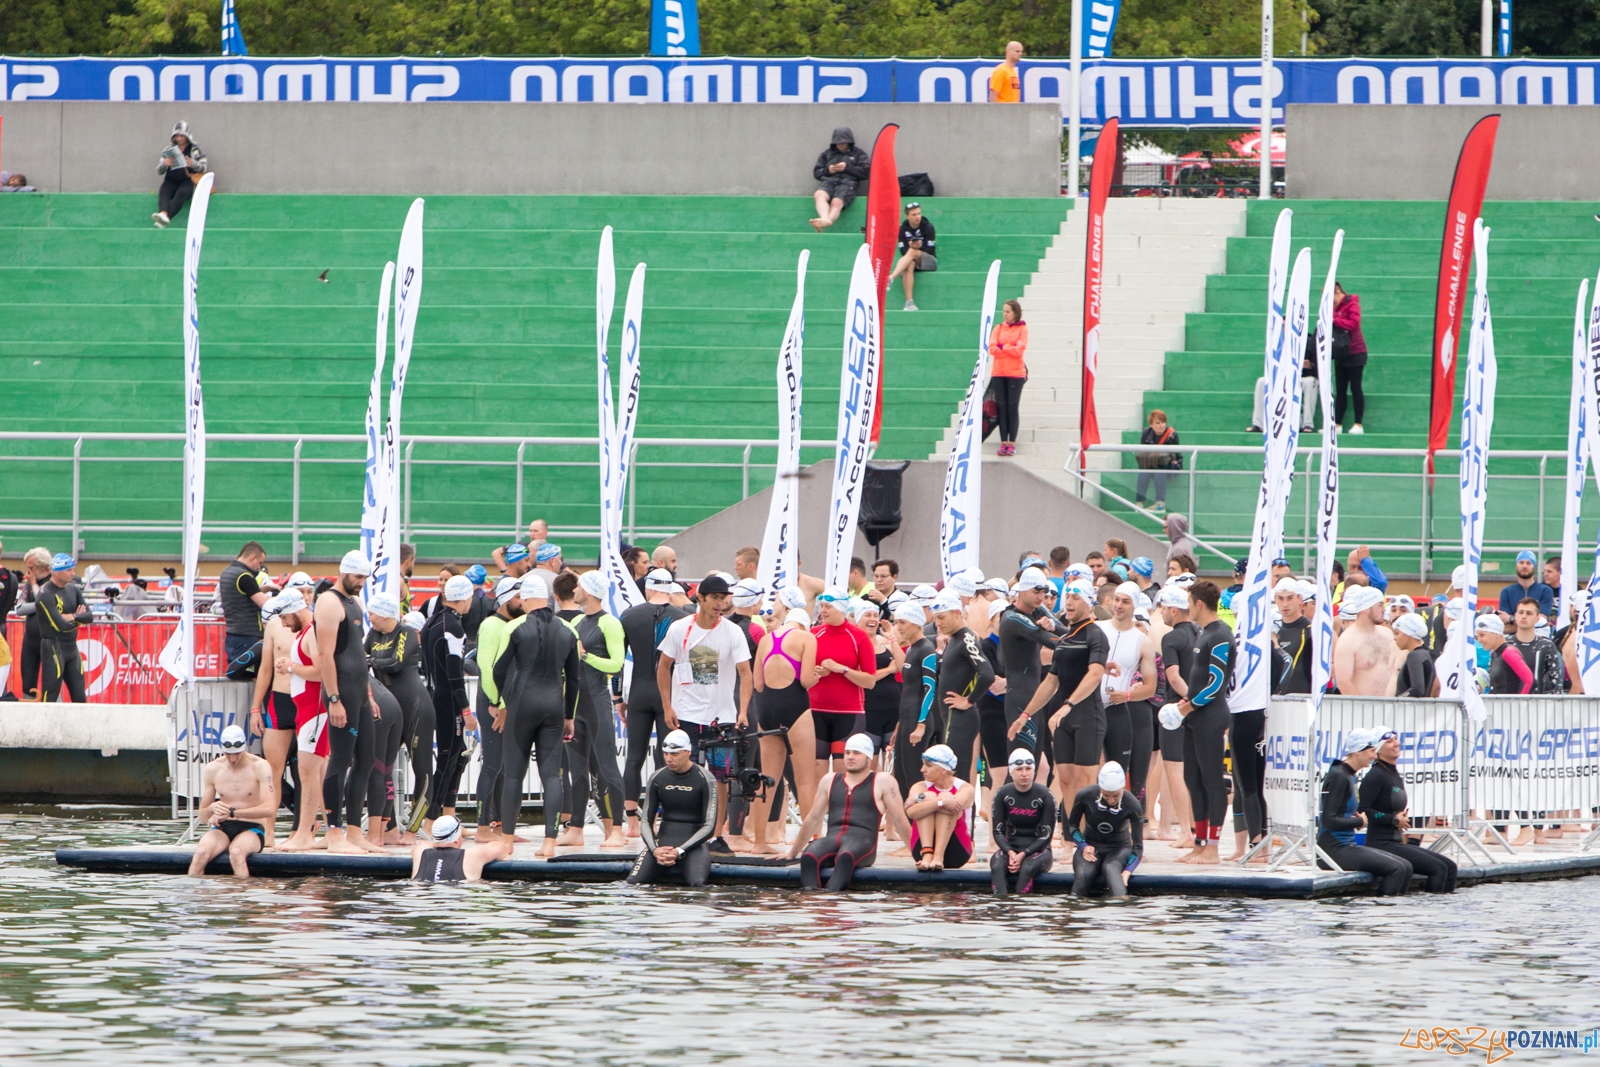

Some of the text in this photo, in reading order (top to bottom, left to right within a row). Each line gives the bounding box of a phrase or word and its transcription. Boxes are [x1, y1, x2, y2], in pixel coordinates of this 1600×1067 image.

[118, 653, 218, 669] CHALGE
[116, 670, 165, 685] FAMILY
[1471, 727, 1534, 764] AQUA
[665, 784, 693, 792] orca
